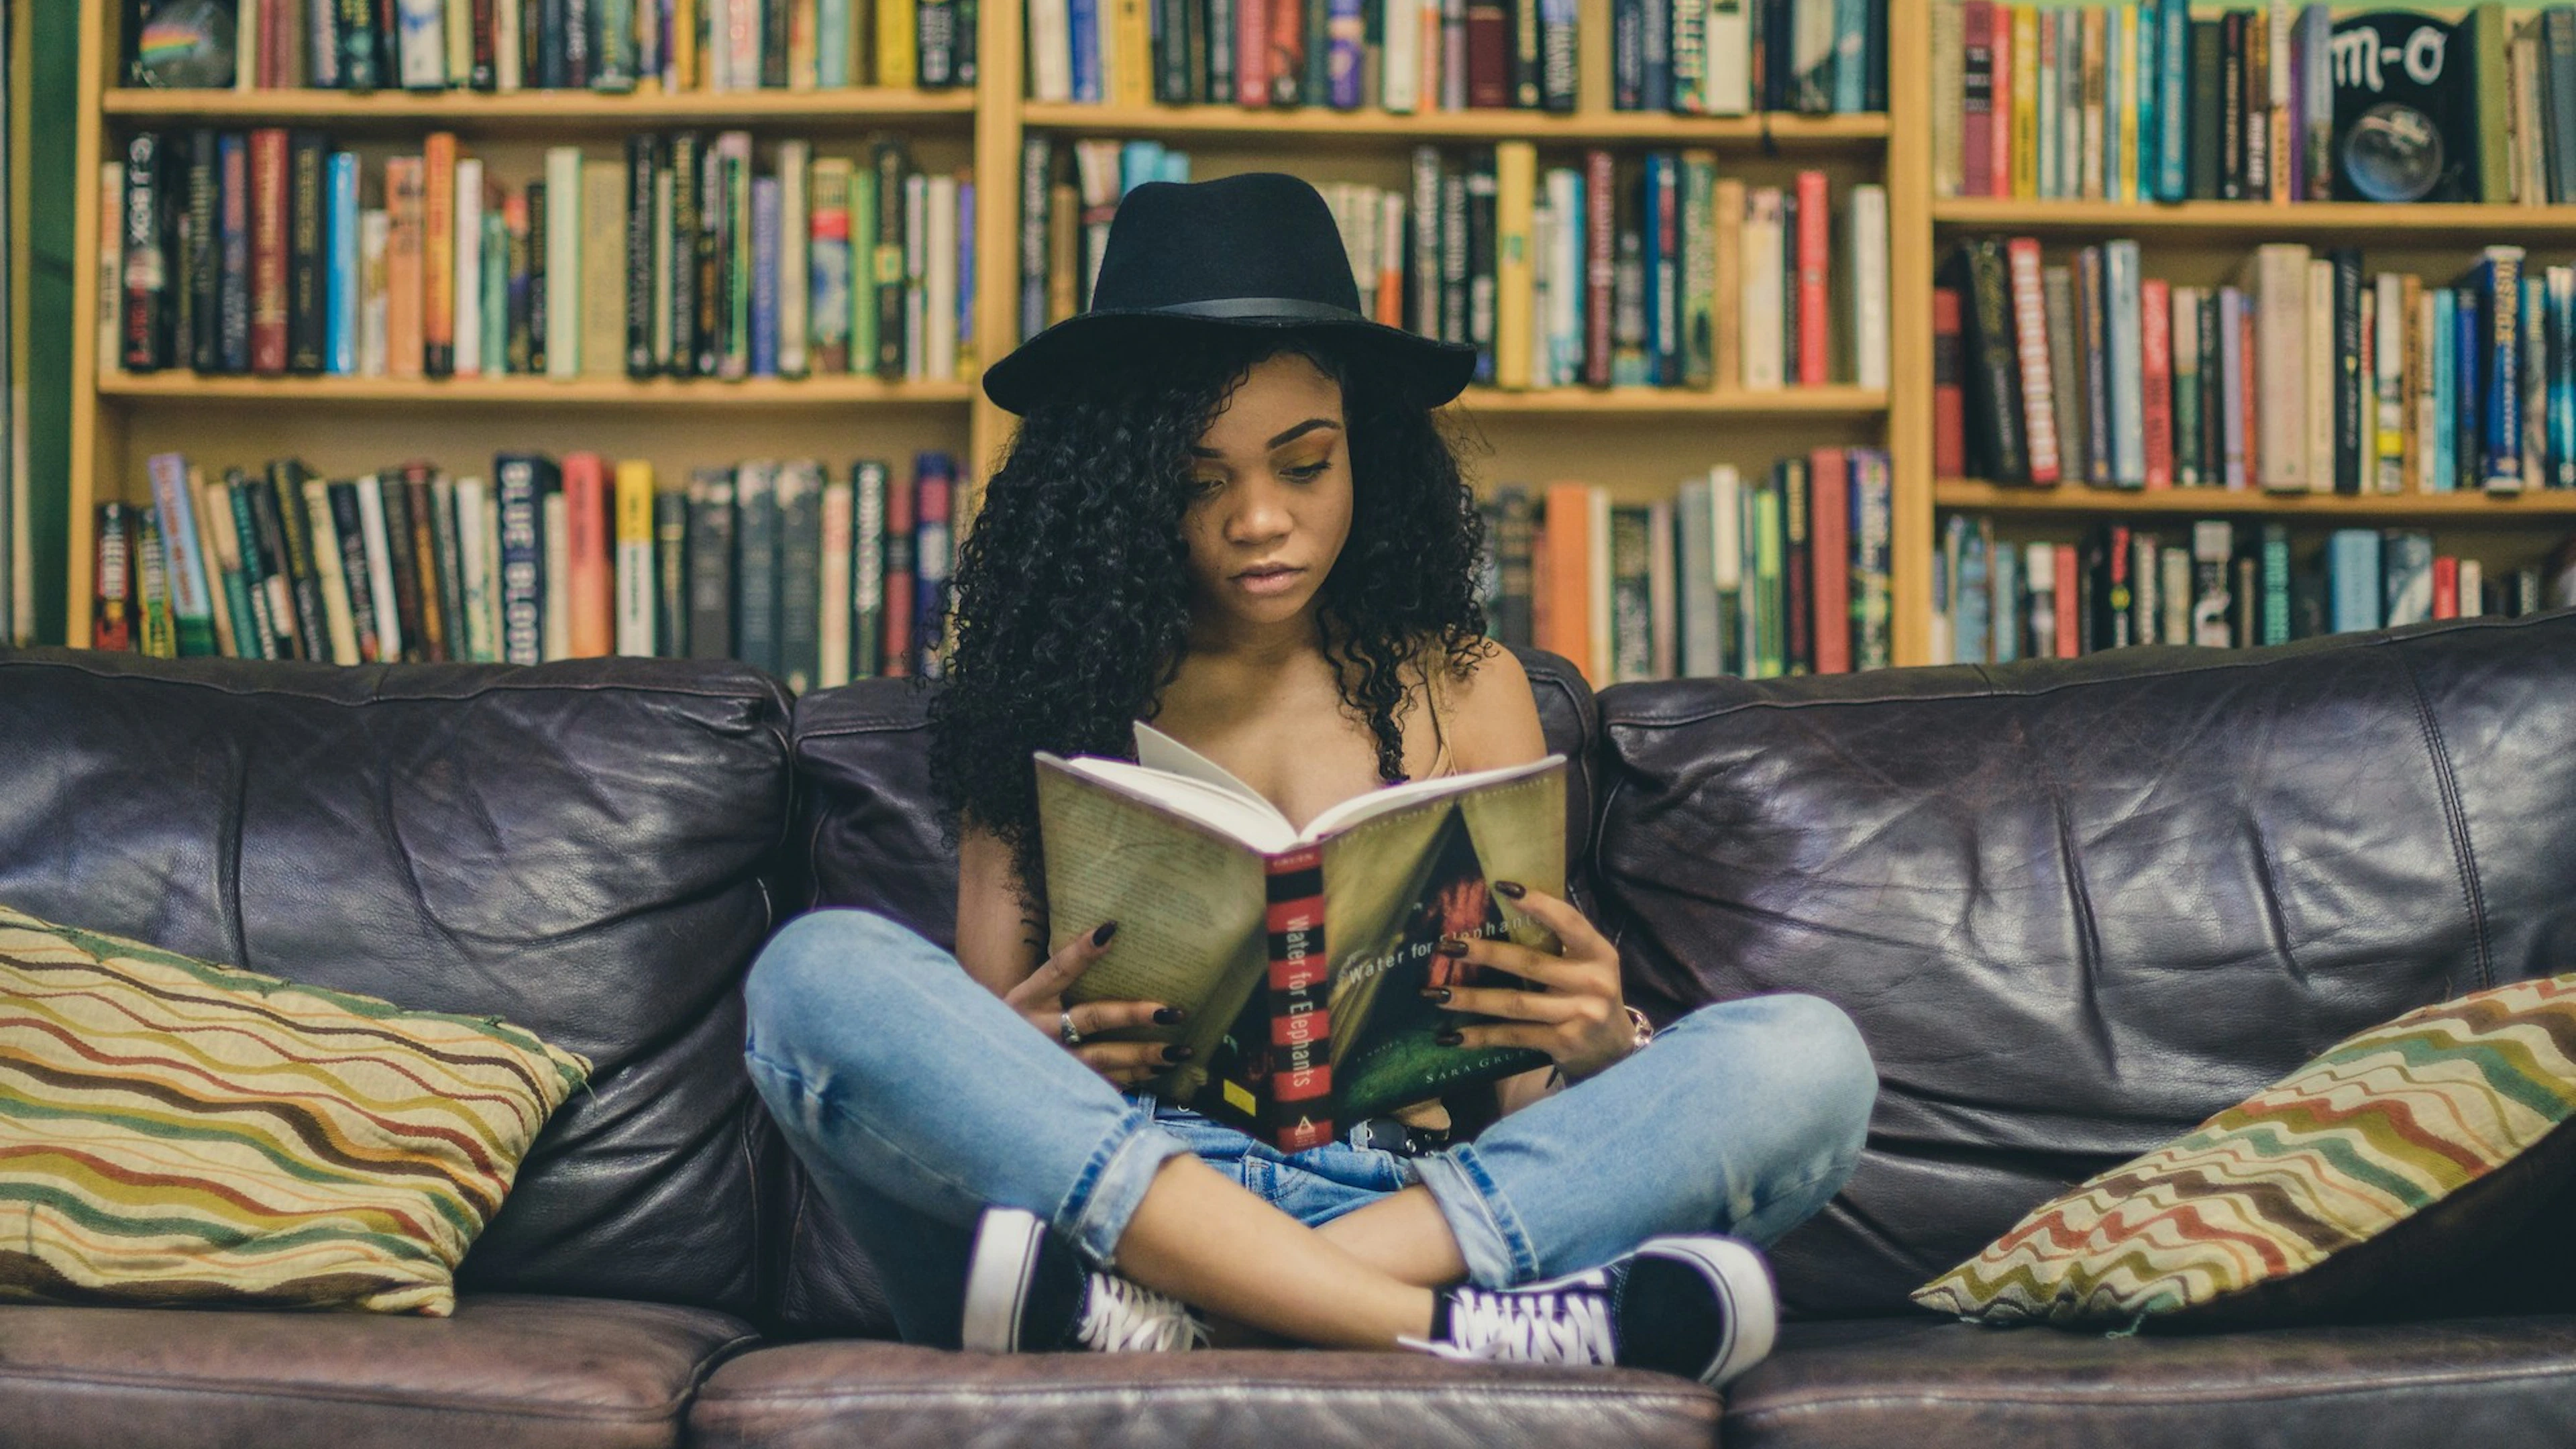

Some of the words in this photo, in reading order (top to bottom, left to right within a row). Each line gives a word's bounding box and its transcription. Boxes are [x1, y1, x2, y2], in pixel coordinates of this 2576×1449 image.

[502, 462, 535, 549] BLUE
[1287, 914, 1310, 966] Water
[1349, 951, 1405, 984] Water
[1411, 941, 1434, 959] for
[1439, 914, 1543, 943] Elephant
[1289, 971, 1313, 997] for
[1287, 1001, 1315, 1088] Elephants
[1426, 1064, 1471, 1084] SARA
